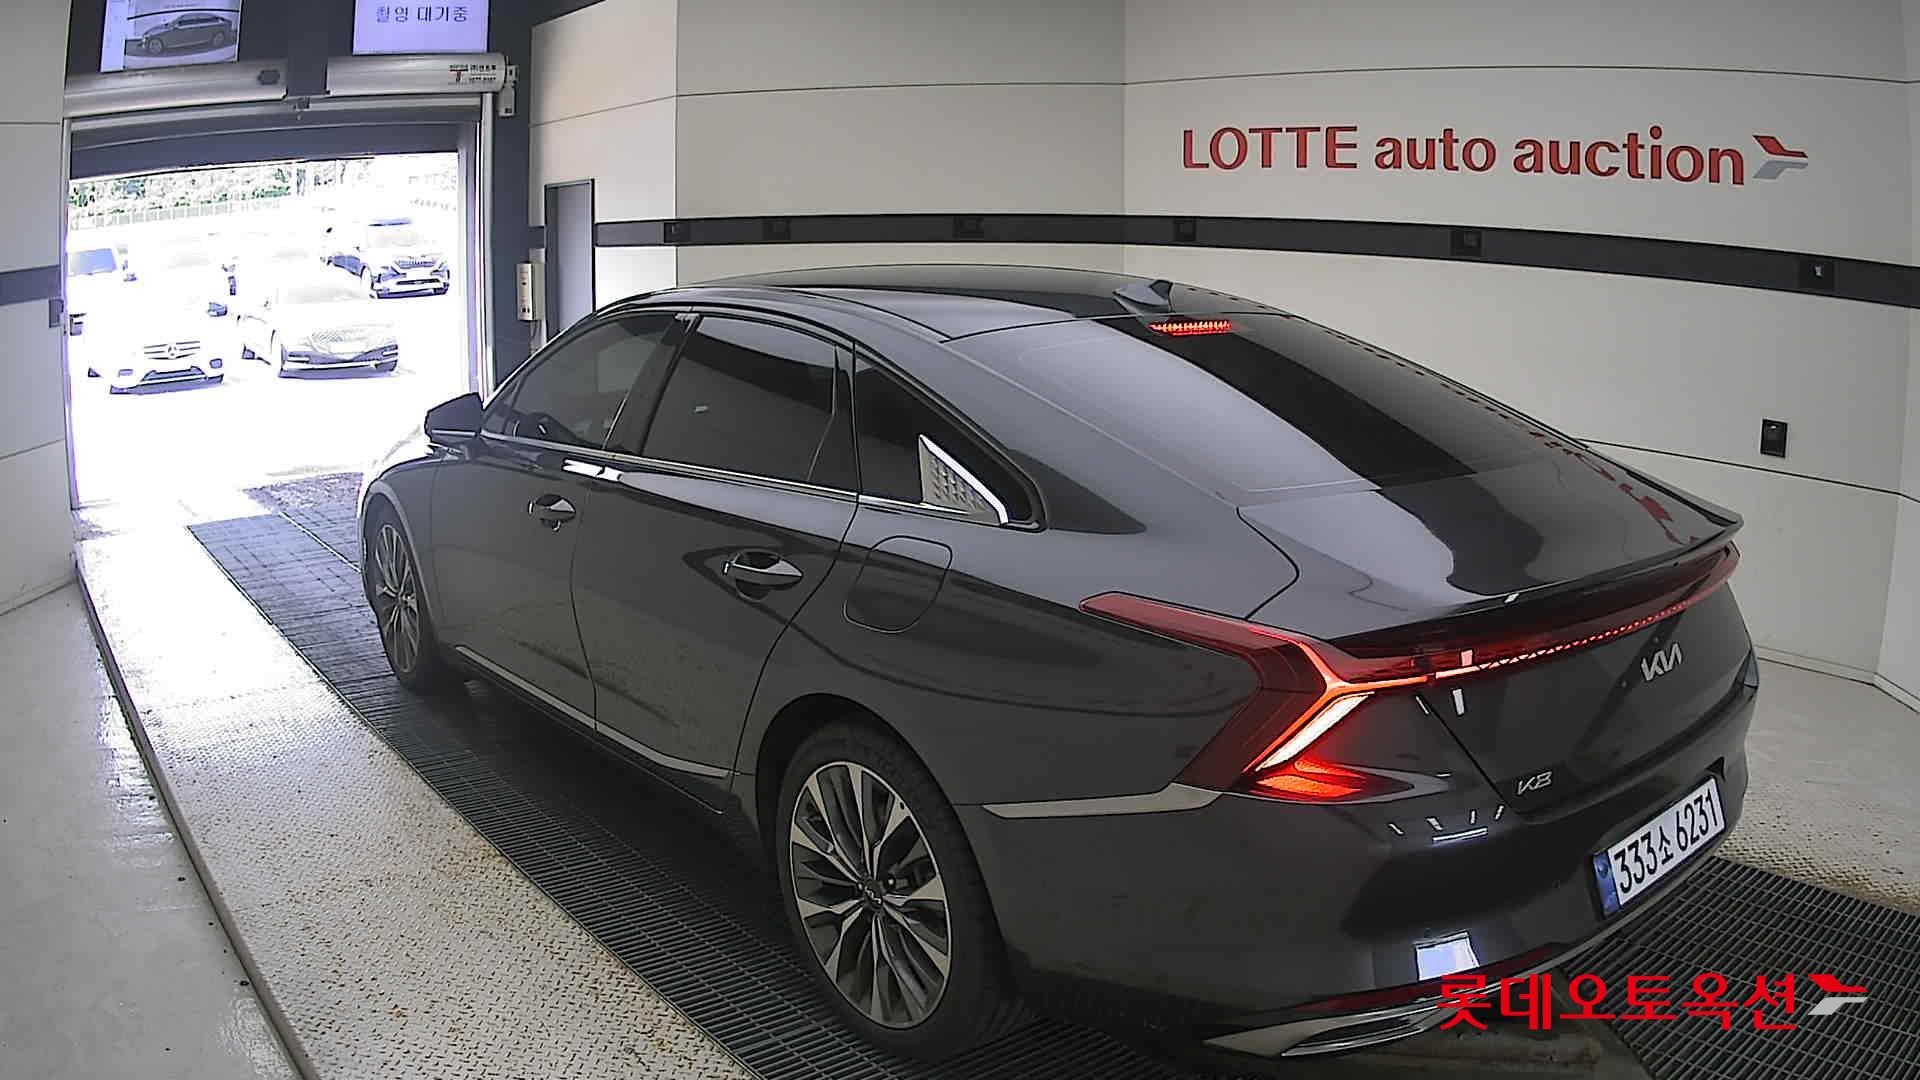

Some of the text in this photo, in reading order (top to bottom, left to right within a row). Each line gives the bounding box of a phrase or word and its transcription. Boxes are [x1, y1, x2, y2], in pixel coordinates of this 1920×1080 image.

[417, 6, 467, 23] 대기중
[1183, 125, 1745, 185] LOTTE auto auction
[1516, 771, 1553, 796] K8
